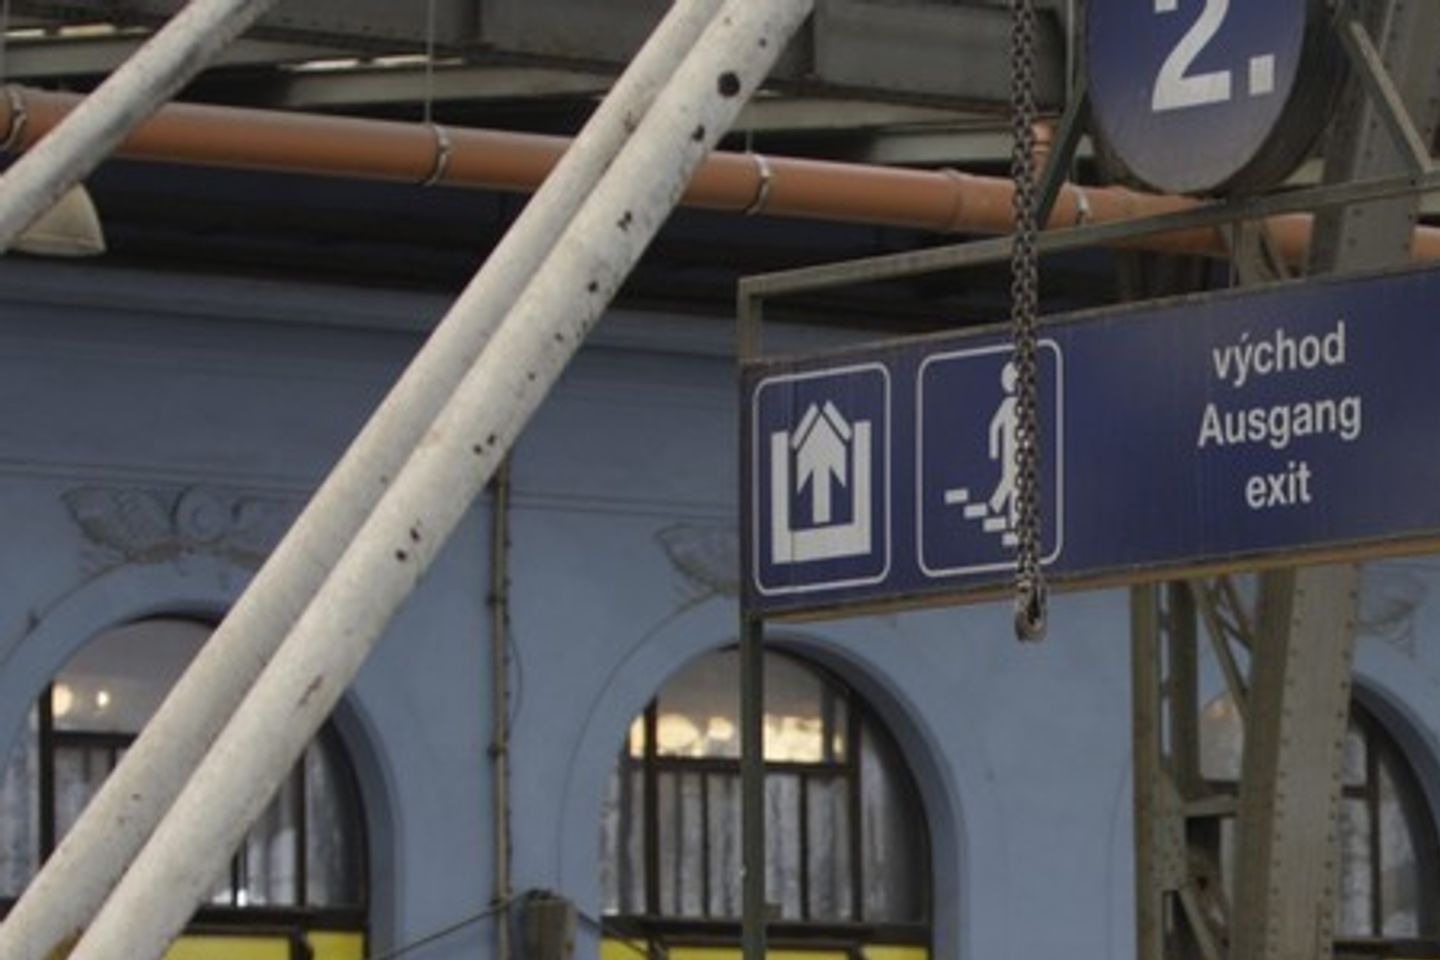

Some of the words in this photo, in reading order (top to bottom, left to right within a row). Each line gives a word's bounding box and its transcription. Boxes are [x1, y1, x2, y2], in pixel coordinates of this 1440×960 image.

[1151, 0, 1274, 112] 2.
[1212, 319, 1346, 387] východ
[1197, 395, 1362, 450] Ausgang
[1245, 461, 1312, 509] exit
